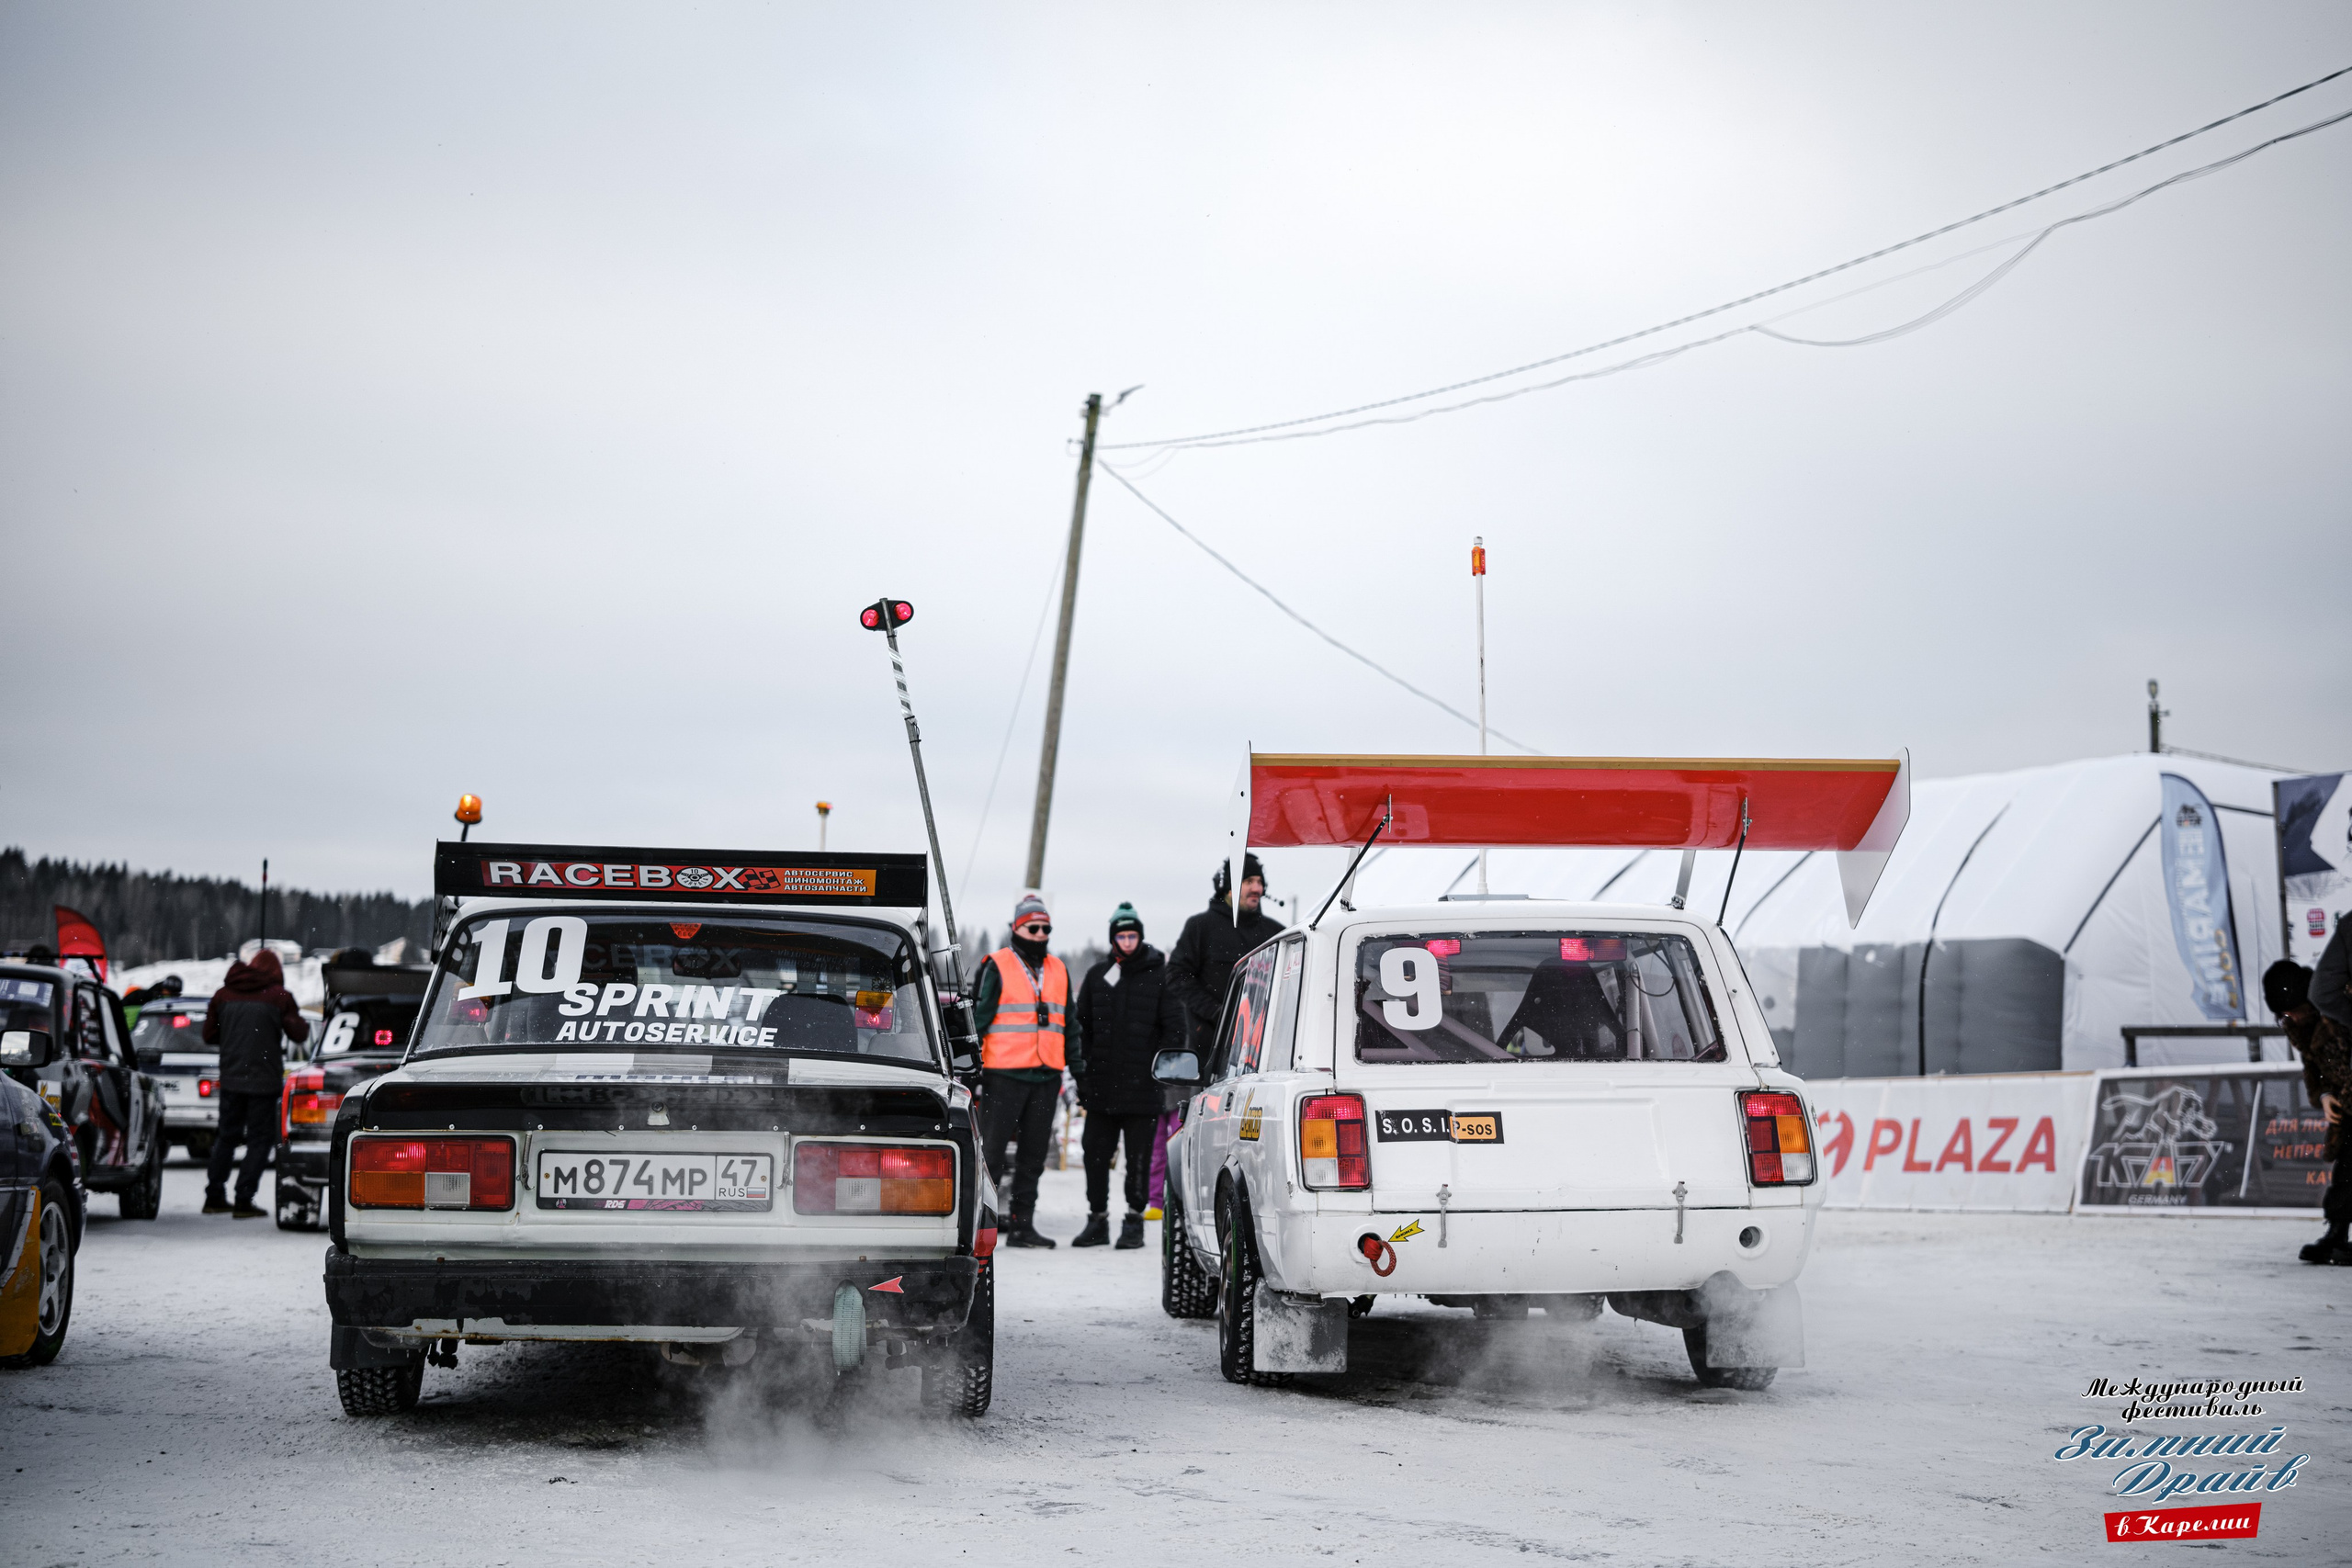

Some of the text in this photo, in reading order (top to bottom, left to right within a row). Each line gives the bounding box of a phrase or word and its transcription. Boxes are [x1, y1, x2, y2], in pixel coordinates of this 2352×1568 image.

[489, 862, 745, 889] RACEBOX
[784, 869, 854, 877] АВТОСЕРВИС
[458, 916, 588, 1002] 10
[558, 983, 781, 1021] SPRINT
[1380, 947, 1442, 1031] 9
[322, 1012, 360, 1054] 6
[555, 1021, 778, 1047] AUTOSERVICE
[2265, 1118, 2299, 1136] ДЛЯ
[1863, 1115, 2056, 1173] PLAZA
[553, 1159, 758, 1195] М874МР 47
[718, 1188, 746, 1198] RUS
[2128, 1193, 2188, 1205] GERMANY
